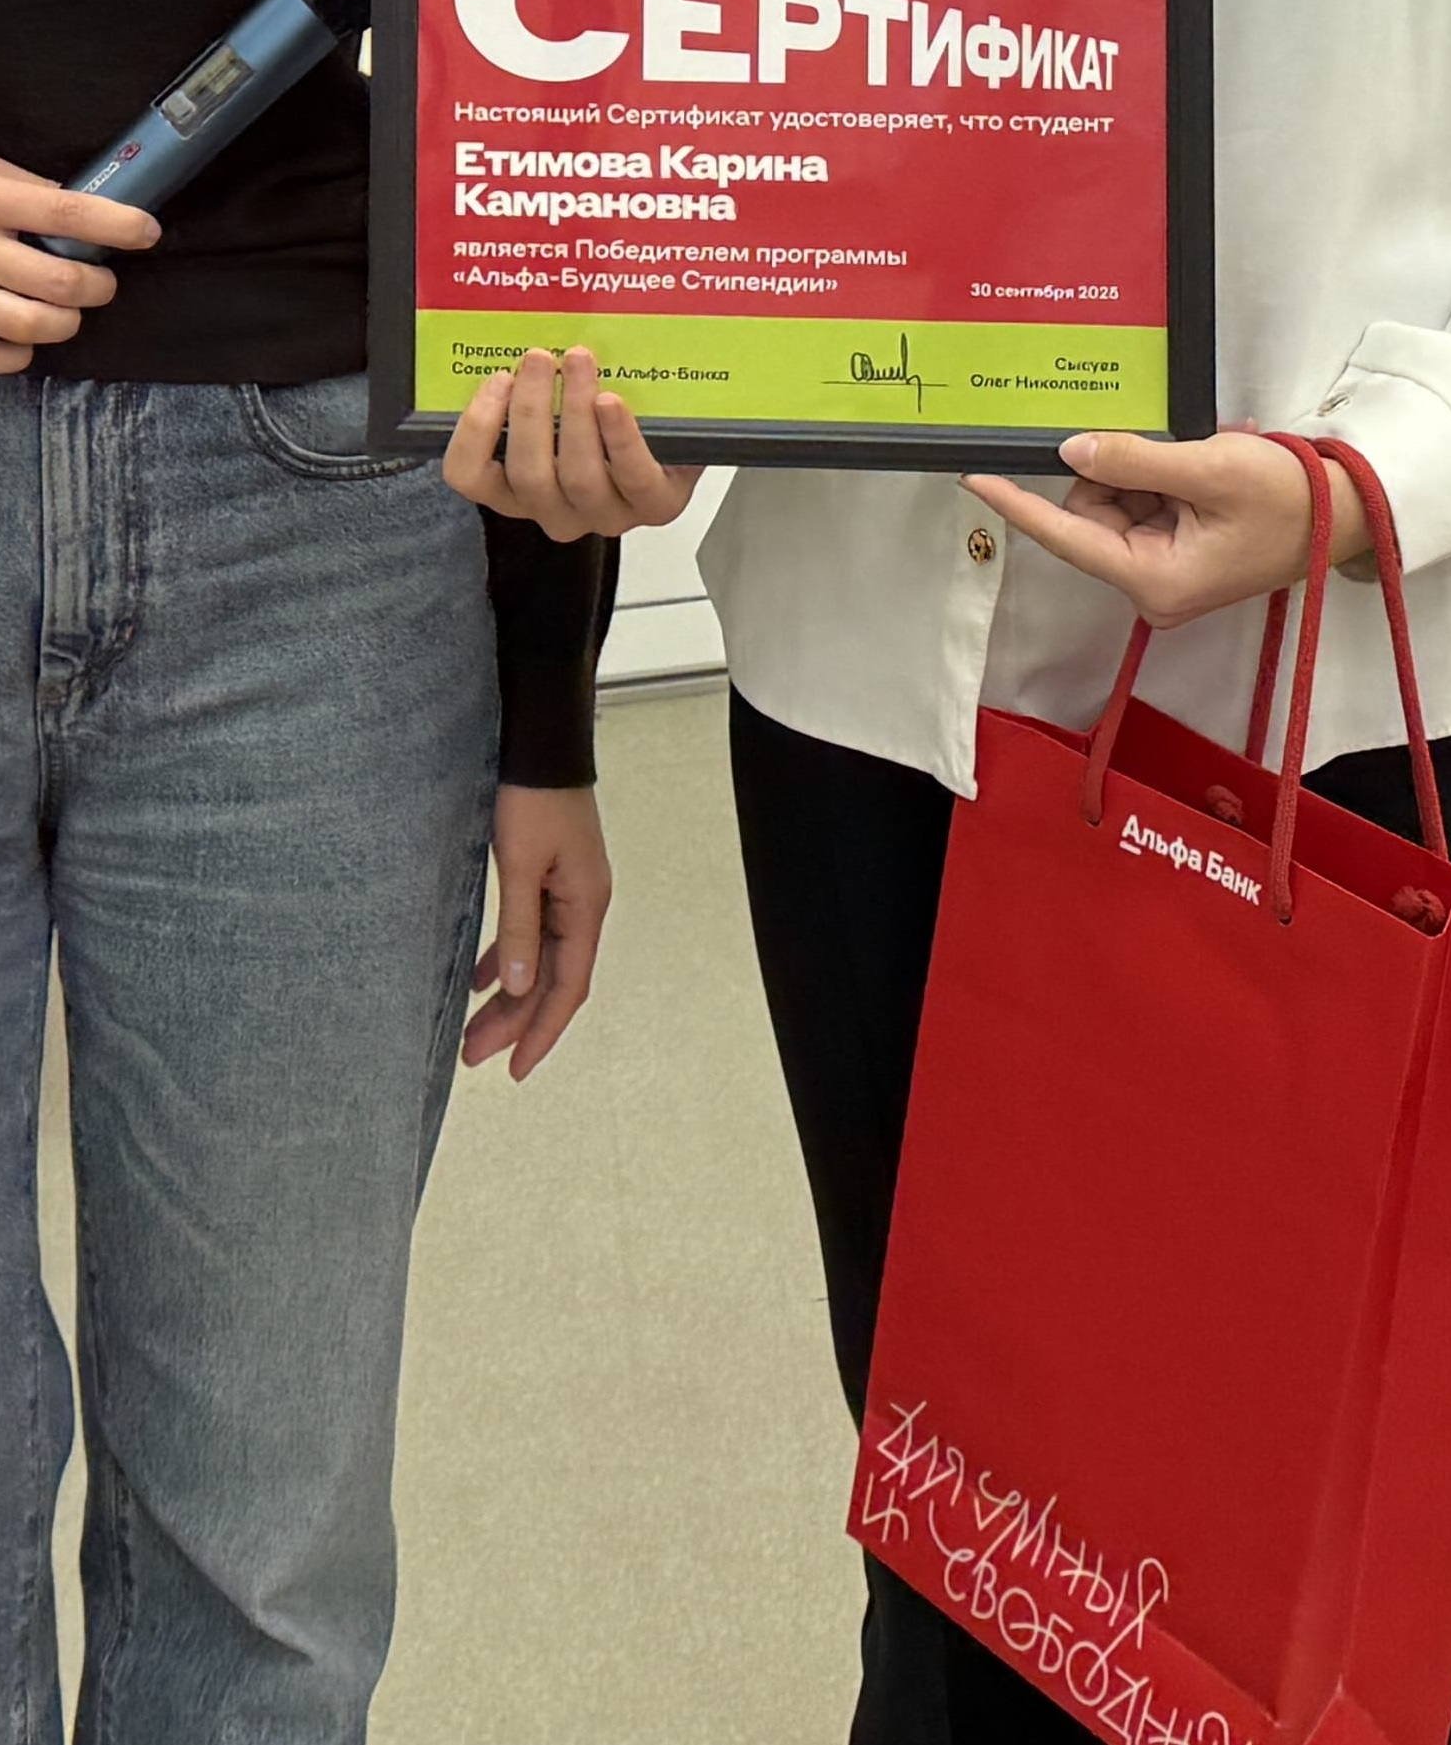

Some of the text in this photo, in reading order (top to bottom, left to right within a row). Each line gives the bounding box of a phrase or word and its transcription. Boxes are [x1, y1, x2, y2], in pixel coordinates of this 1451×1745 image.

[453, 101, 1115, 136] Настоящий Сертификат удостоверяет, что студент
[455, 141, 829, 189] Етимова Карина
[454, 181, 737, 227] Камрановна
[452, 238, 908, 269] является Победителем программы
[452, 266, 839, 296] «Альфа-Будущее Стипендии»
[970, 282, 1120, 302] 30 сентября 2025
[970, 373, 1012, 390] Олег
[1119, 814, 1263, 907] Альфа Банк
